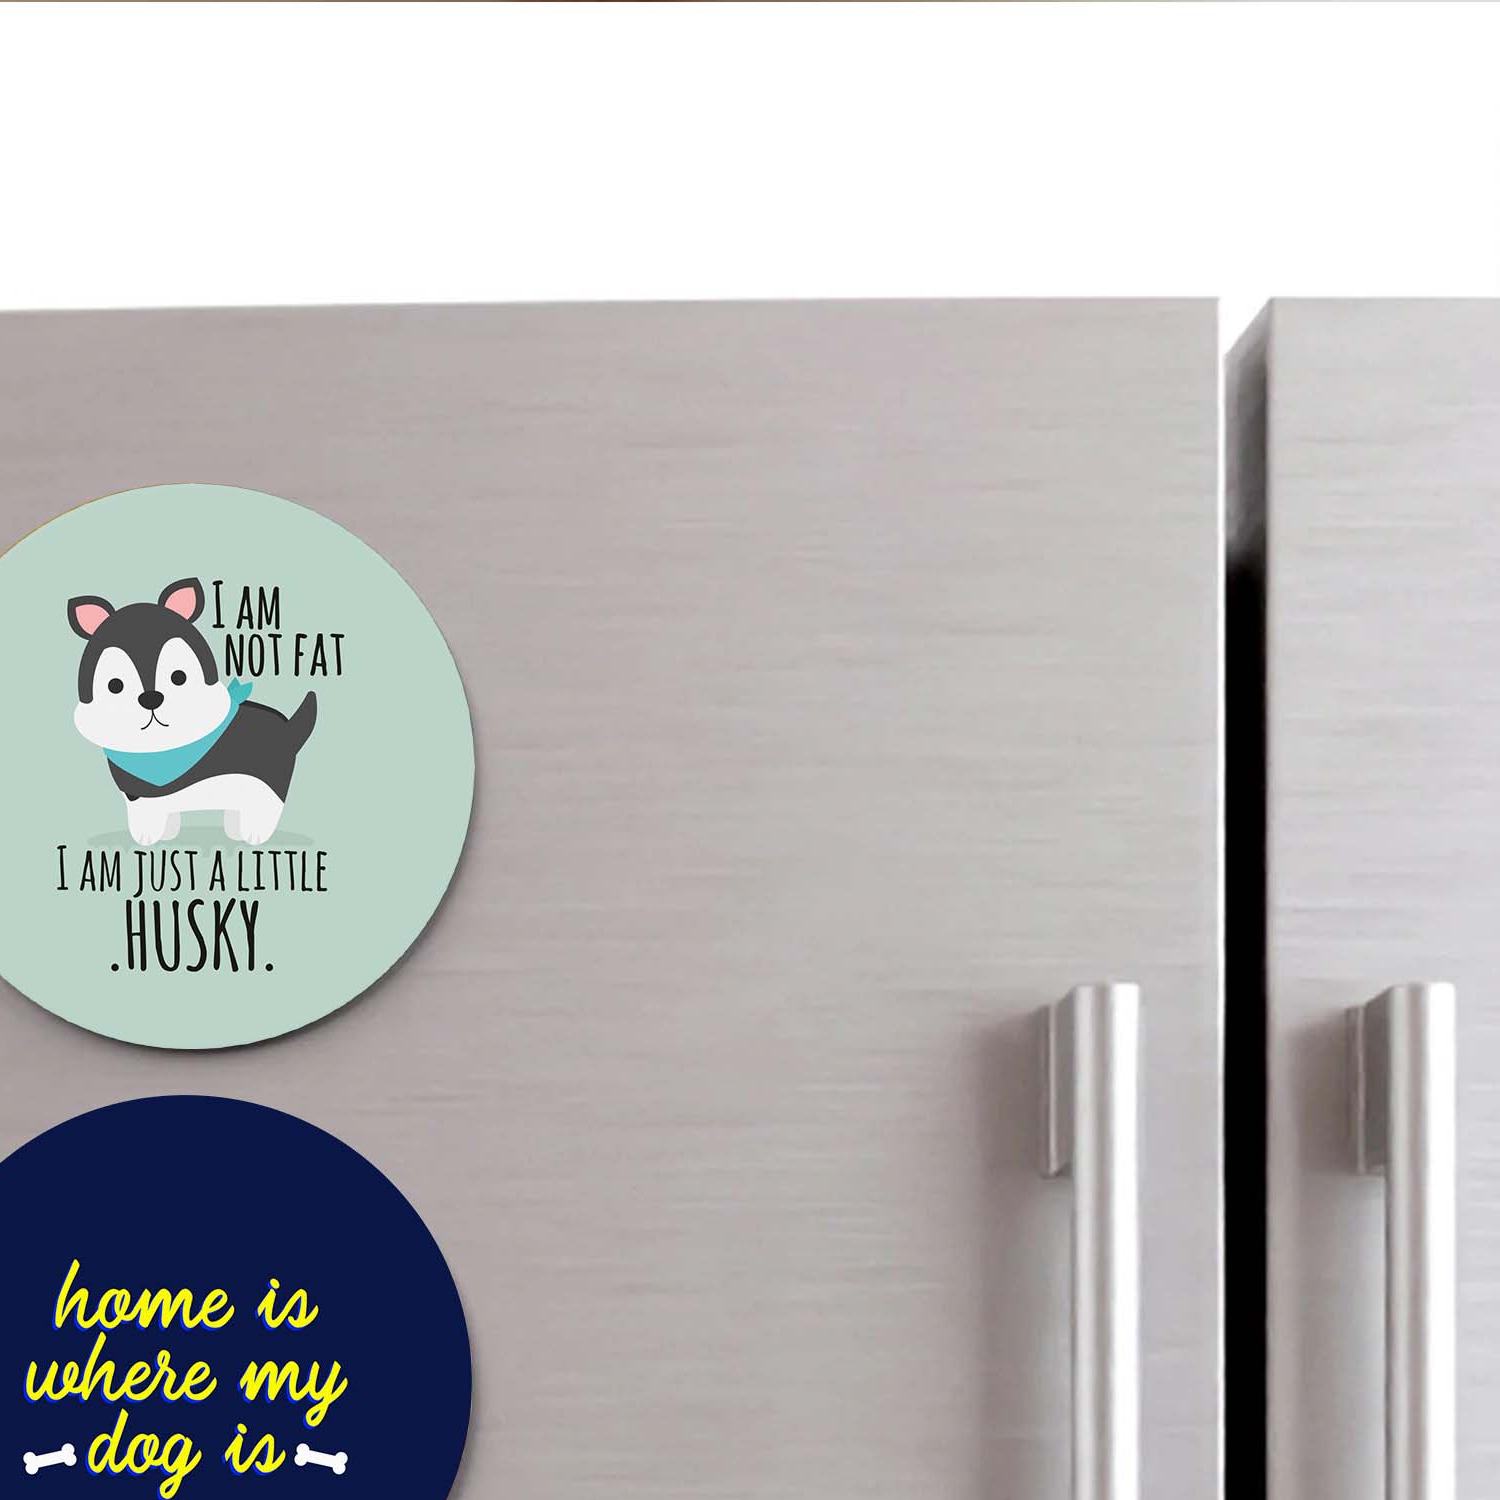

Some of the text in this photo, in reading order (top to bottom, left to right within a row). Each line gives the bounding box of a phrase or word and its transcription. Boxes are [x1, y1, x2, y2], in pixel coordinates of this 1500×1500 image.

[212, 580, 281, 630] I AM
[225, 633, 345, 677] NOT FAT
[56, 844, 328, 899] I AM JUST A LITTLE
[53, 1258, 319, 1331] home is
[23, 1331, 349, 1429] where my
[223, 1423, 286, 1476] is
